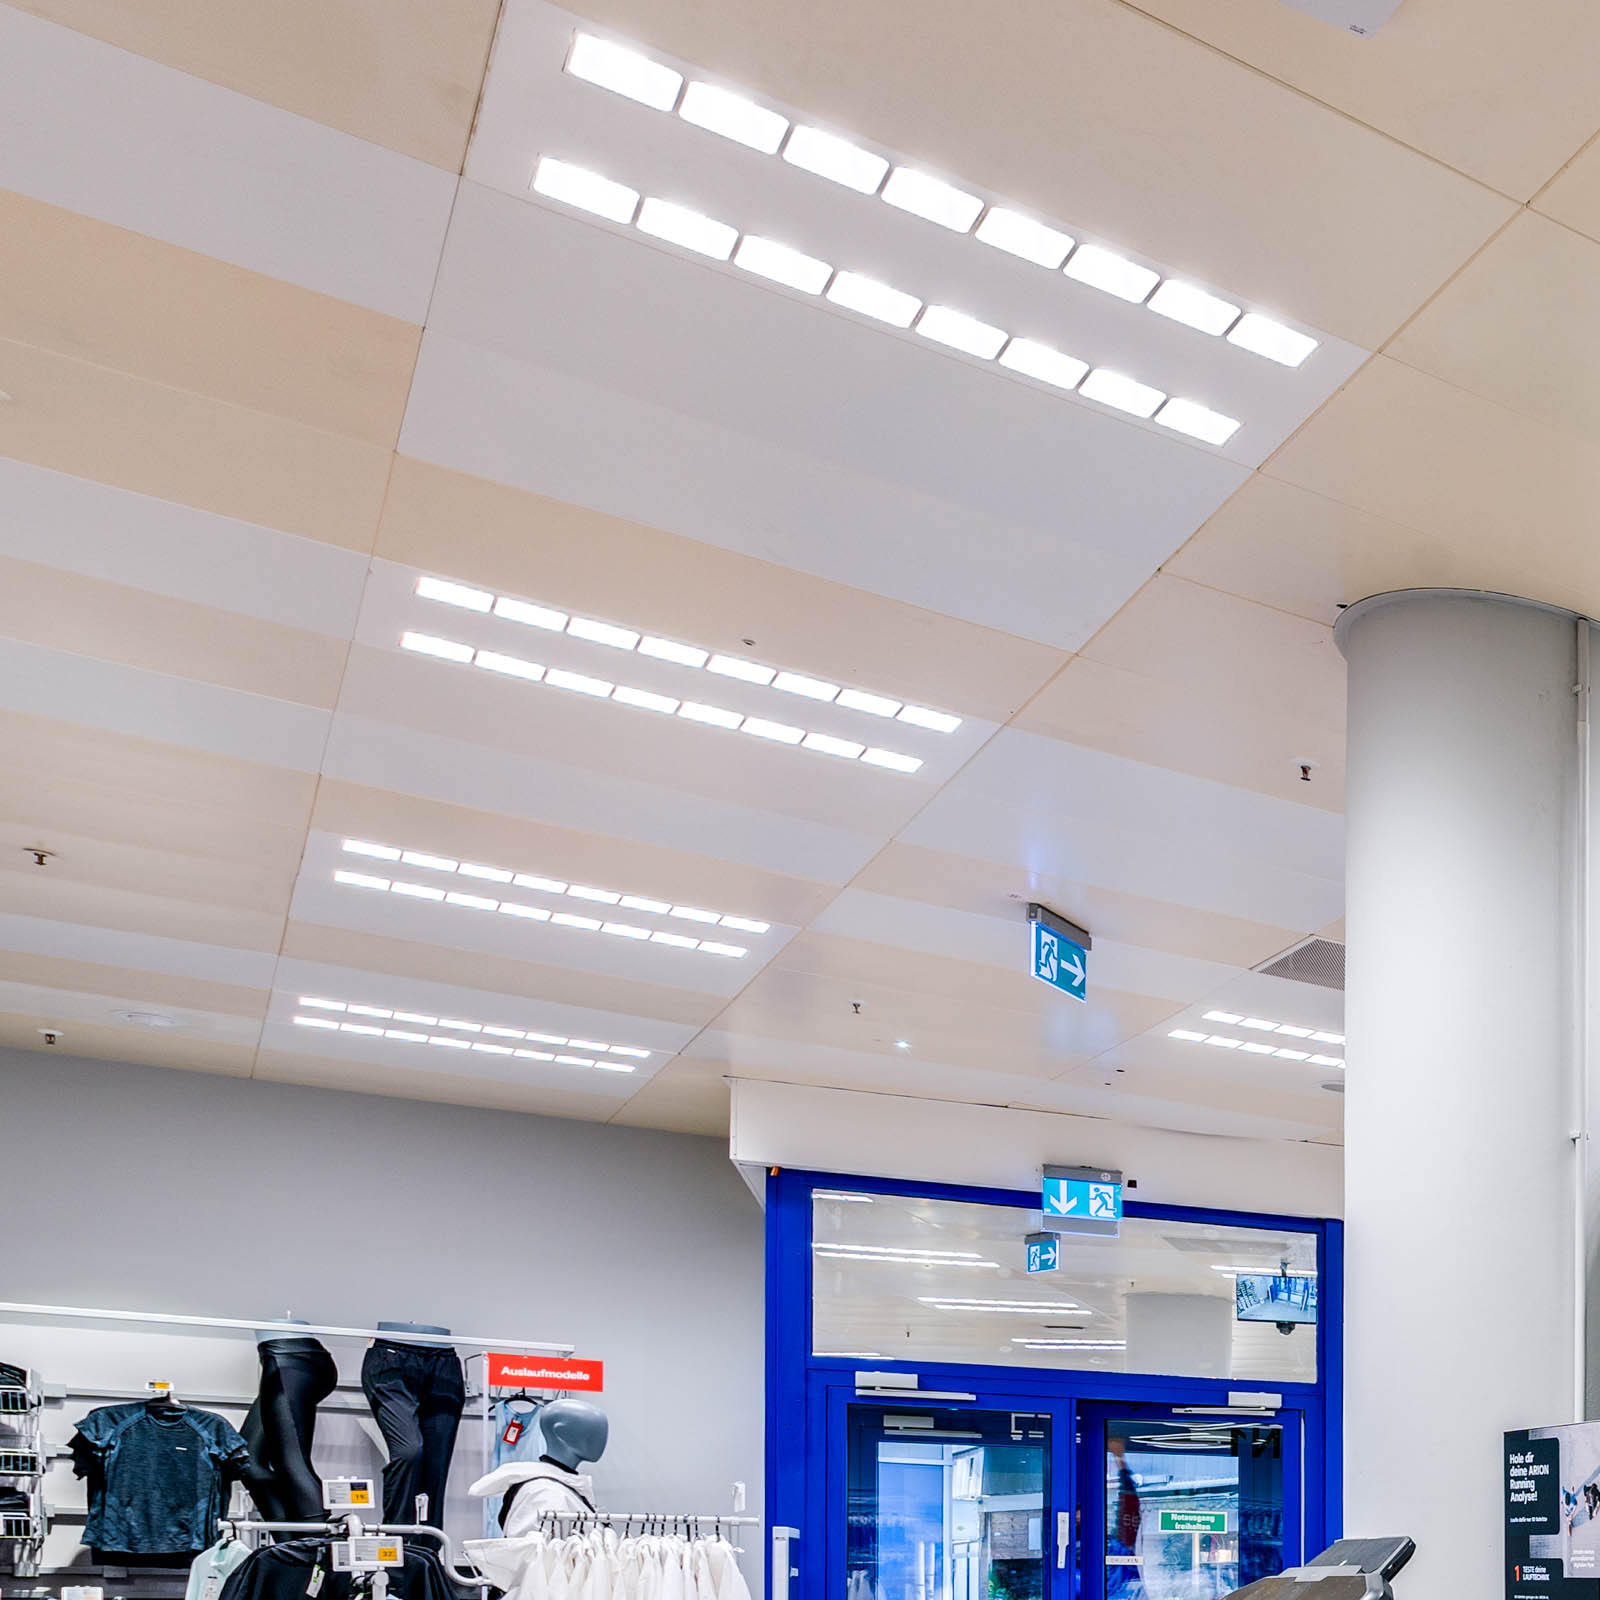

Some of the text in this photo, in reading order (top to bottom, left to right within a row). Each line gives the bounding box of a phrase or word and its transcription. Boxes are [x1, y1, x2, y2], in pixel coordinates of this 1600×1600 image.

[501, 1366, 590, 1381] Auslaufmodelle
[1509, 1451, 1535, 1464] Hole dir
[1510, 1464, 1550, 1477] deine ARION
[1510, 1478, 1535, 1491] Running
[1510, 1491, 1538, 1505] Analyse!
[1171, 1513, 1215, 1523] Notausgang
[1175, 1522, 1211, 1530] freihalten
[1514, 1564, 1520, 1581] 1
